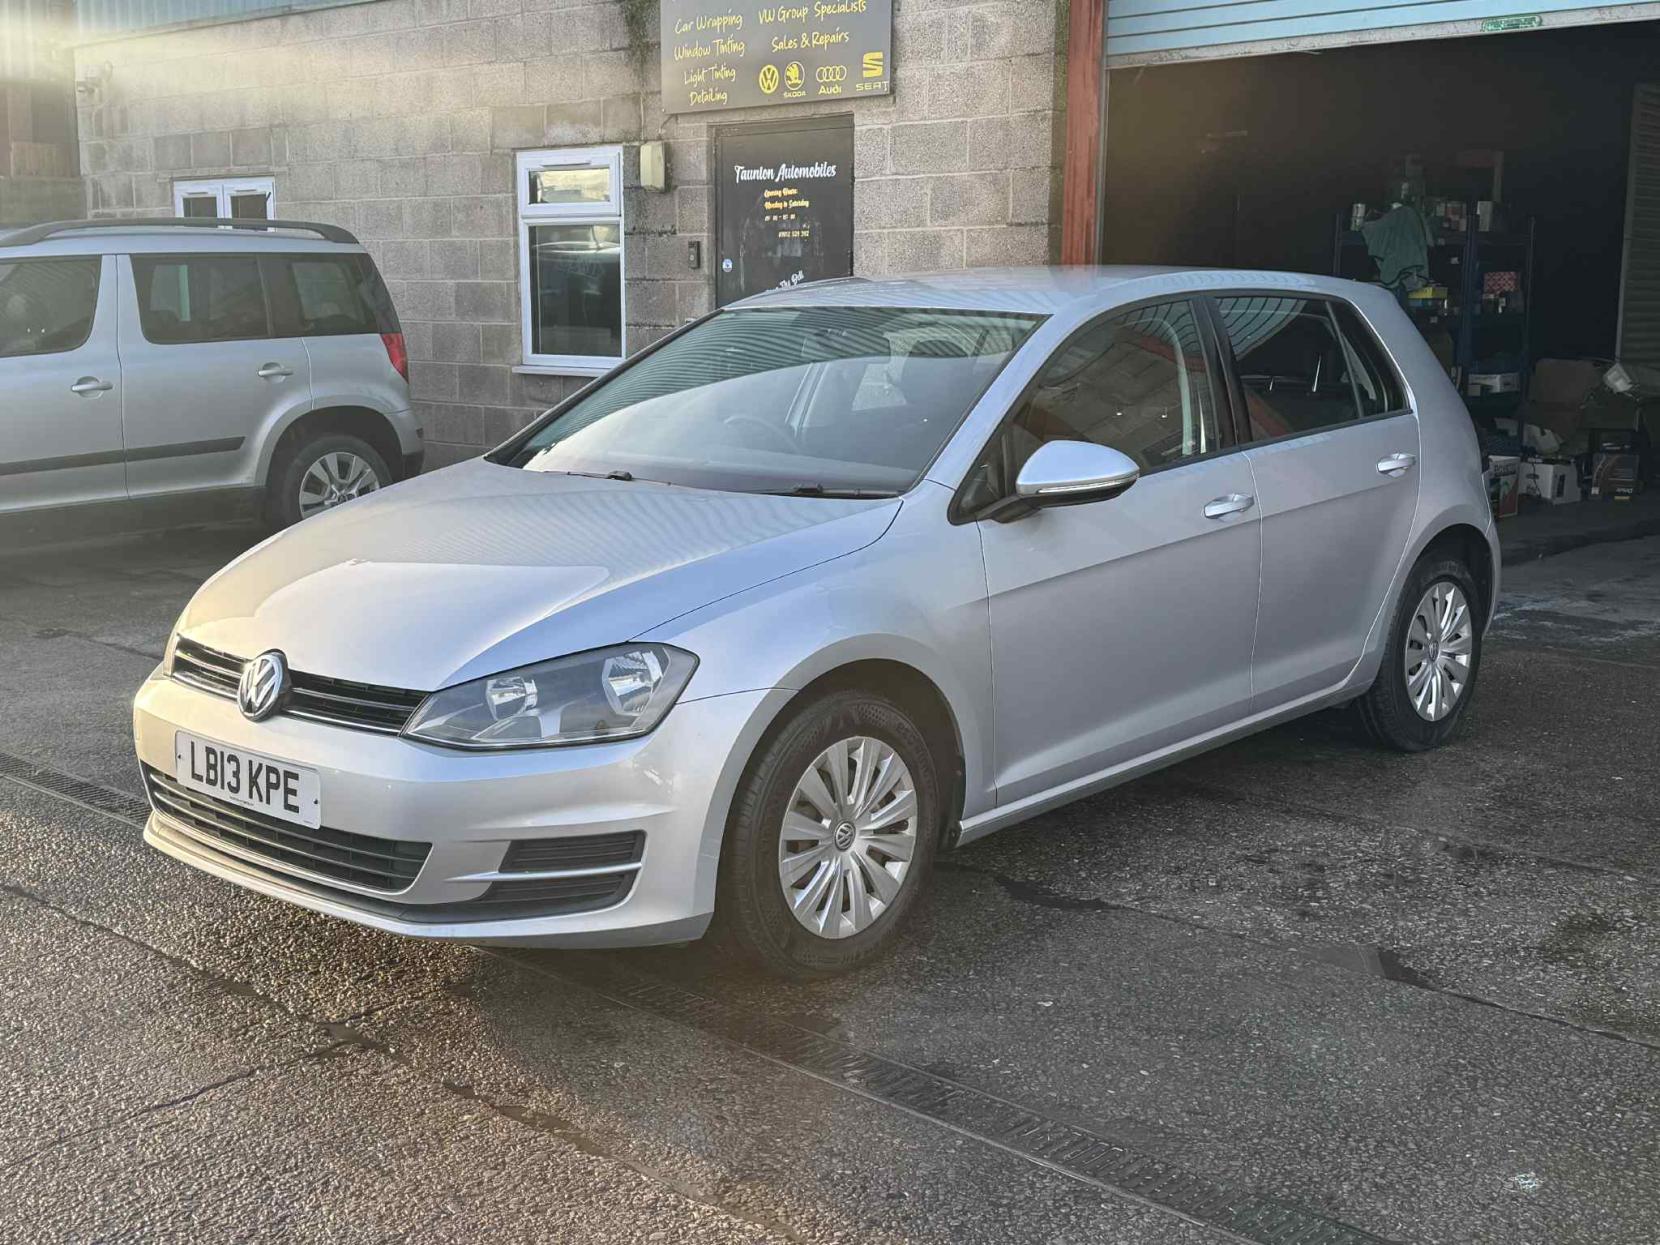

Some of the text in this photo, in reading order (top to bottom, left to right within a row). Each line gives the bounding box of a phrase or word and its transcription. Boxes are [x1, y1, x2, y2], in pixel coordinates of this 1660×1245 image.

[674, 8, 743, 34] Car Wrapping
[758, 0, 867, 25] VW Group Specialists
[674, 33, 745, 61] Window Tinting
[771, 26, 850, 53] Sales & Repairs
[684, 62, 736, 88] Light Tinting
[855, 80, 890, 92] SEAT
[689, 87, 728, 106] Detailing
[818, 84, 842, 96] Audi
[734, 161, 837, 184] Taunton Automobiles
[191, 740, 300, 814] LB13 KPE
